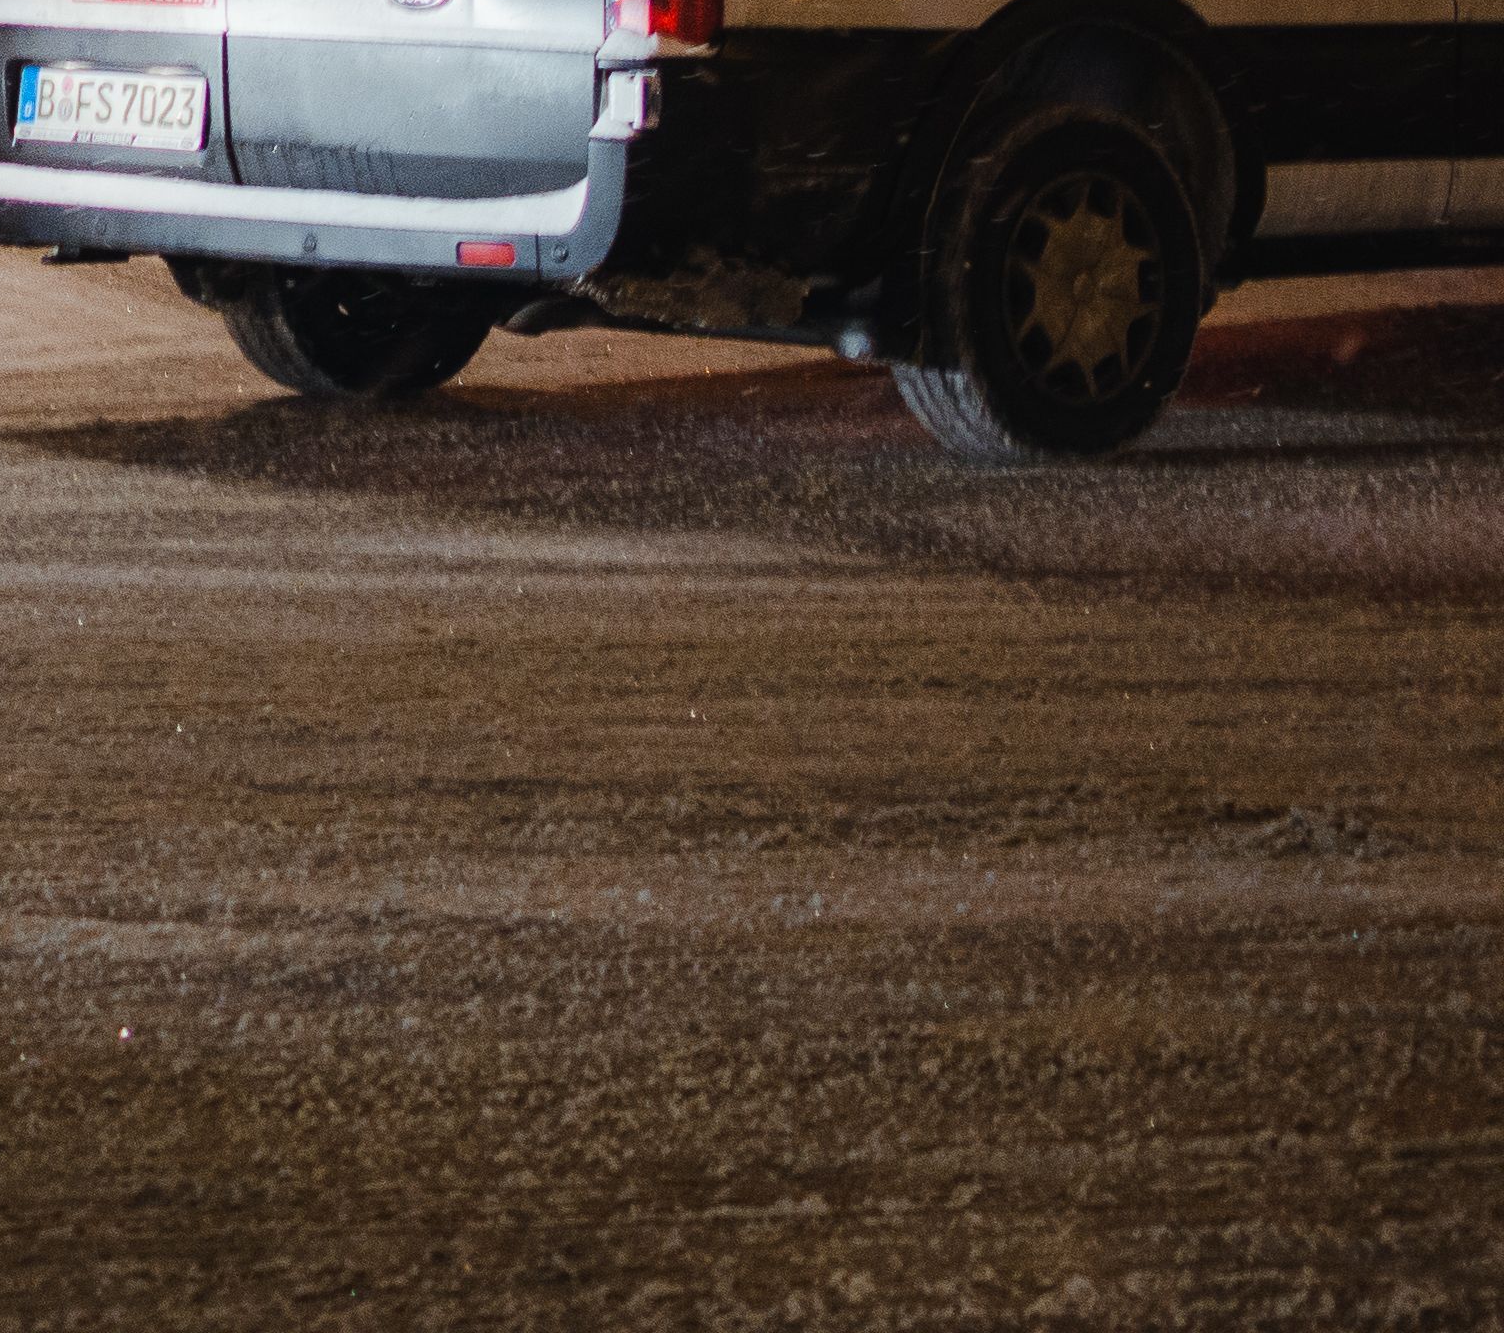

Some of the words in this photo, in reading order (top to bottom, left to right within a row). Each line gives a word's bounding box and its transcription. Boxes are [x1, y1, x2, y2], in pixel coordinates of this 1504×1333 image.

[39, 79, 55, 120] B
[76, 82, 113, 124] FS
[122, 83, 196, 127] 7023
